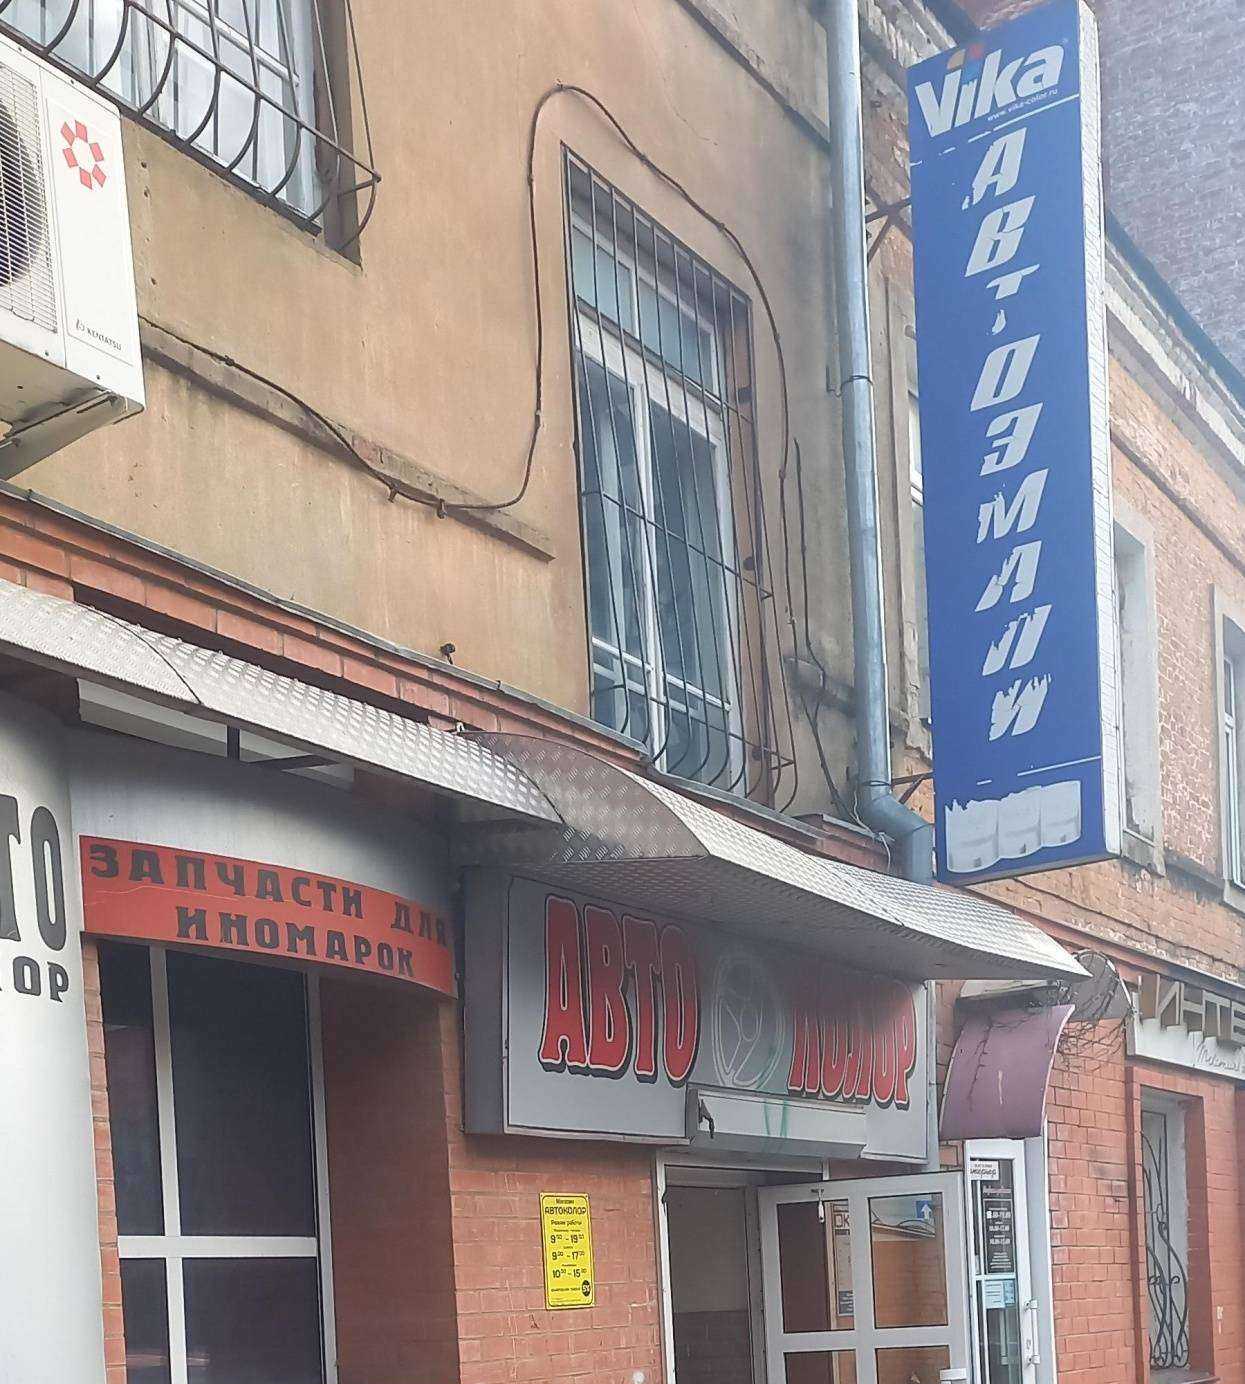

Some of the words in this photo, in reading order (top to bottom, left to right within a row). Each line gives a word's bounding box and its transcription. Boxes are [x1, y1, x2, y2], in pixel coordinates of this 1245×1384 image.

[915, 44, 1065, 138] Vika
[88, 843, 364, 920] ЗАПЧАСТИ
[390, 899, 448, 948] ДЛЯ
[175, 904, 415, 978] ИНОМАРОК
[538, 893, 701, 1089] АВТО
[544, 1206, 587, 1215] АВТОКОЛОР
